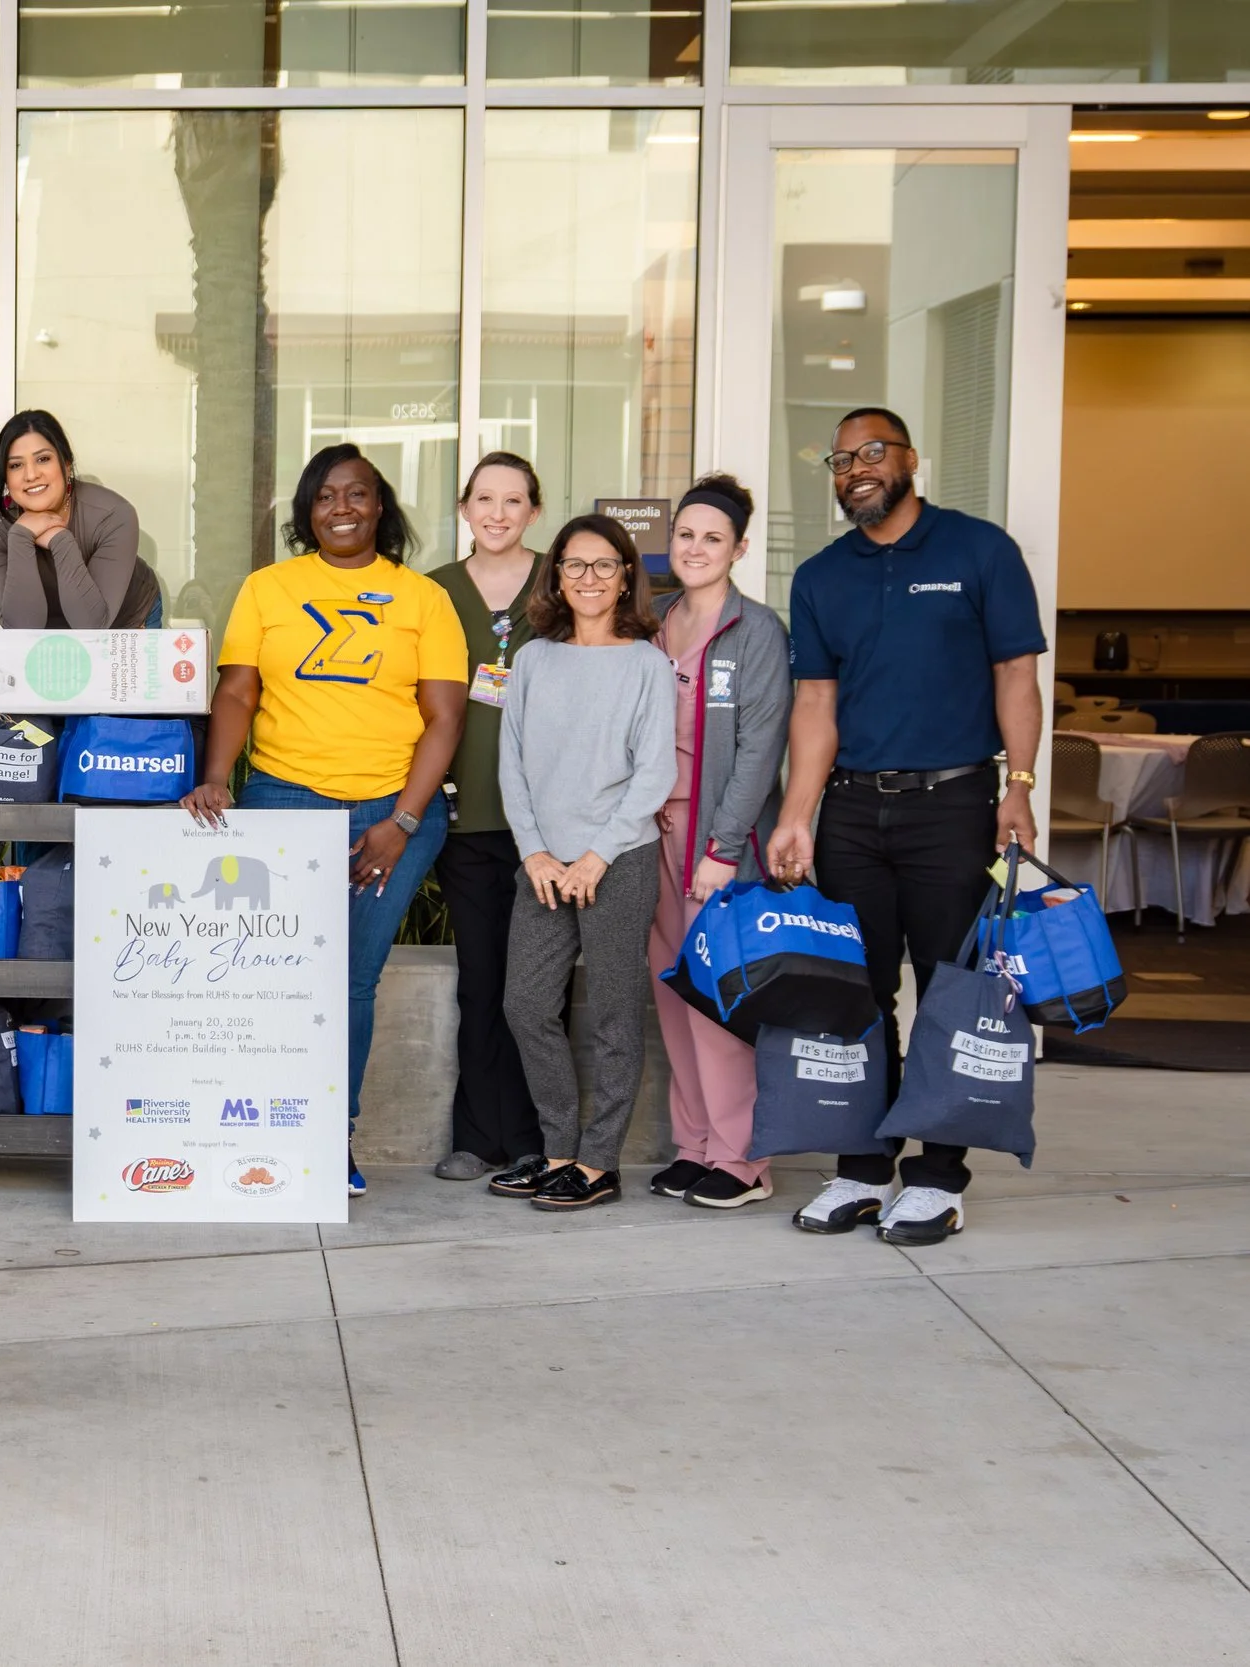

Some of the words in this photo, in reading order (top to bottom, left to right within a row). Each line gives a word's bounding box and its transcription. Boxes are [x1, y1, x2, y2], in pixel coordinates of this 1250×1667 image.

[605, 506, 661, 519] Magnolia
[618, 520, 650, 530] oom
[920, 582, 962, 592] marsell
[110, 633, 118, 656] Swing
[120, 633, 128, 667] Compact
[144, 632, 162, 700] ingenuity
[110, 662, 118, 701] Chambray
[120, 668, 128, 702] Soothing
[20, 752, 38, 762] for
[96, 754, 185, 773] marsell
[182, 828, 217, 838] Welcome
[232, 829, 245, 837] the
[126, 913, 170, 937] New
[180, 913, 229, 937] Year
[238, 914, 299, 938] NICU
[113, 936, 196, 984] Baby
[207, 933, 312, 982] Shower
[112, 990, 129, 999] New
[132, 990, 149, 999] Year
[152, 990, 184, 1001] Blessings
[187, 990, 203, 999] from
[206, 990, 230, 999] RUHS
[257, 990, 279, 1000] NICU
[281, 991, 312, 1000] Families!
[170, 1017, 203, 1029] January
[206, 1017, 223, 1028] 20,
[227, 1017, 254, 1027] 2026
[166, 1030, 170, 1040] 1
[175, 1032, 194, 1042] p.m.
[197, 1032, 206, 1040] to
[210, 1030, 234, 1040] 2:30
[237, 1033, 256, 1042] p.m.
[115, 1043, 143, 1053] RUHS
[146, 1043, 188, 1053] Education
[192, 1044, 227, 1055] Building
[238, 1043, 277, 1055] Magnolia
[281, 1044, 308, 1054] Rooms
[800, 1044, 821, 1056] It's
[845, 1049, 861, 1060] for
[961, 1038, 979, 1052] It's
[979, 1044, 1008, 1058] time
[1010, 1048, 1022, 1058] for
[805, 1066, 812, 1075] a
[961, 1061, 969, 1070] a
[972, 1063, 1017, 1080] change!
[143, 1099, 190, 1108] Riverside
[270, 1105, 300, 1113] MOMS.
[143, 1107, 190, 1117] University
[270, 1112, 306, 1120] STRONG
[270, 1120, 304, 1128] BABIES.
[237, 1156, 278, 1167] Riverside
[125, 1157, 195, 1192] Cane's
[230, 1181, 258, 1195] Cookie
[259, 1180, 286, 1195] Shoppe
